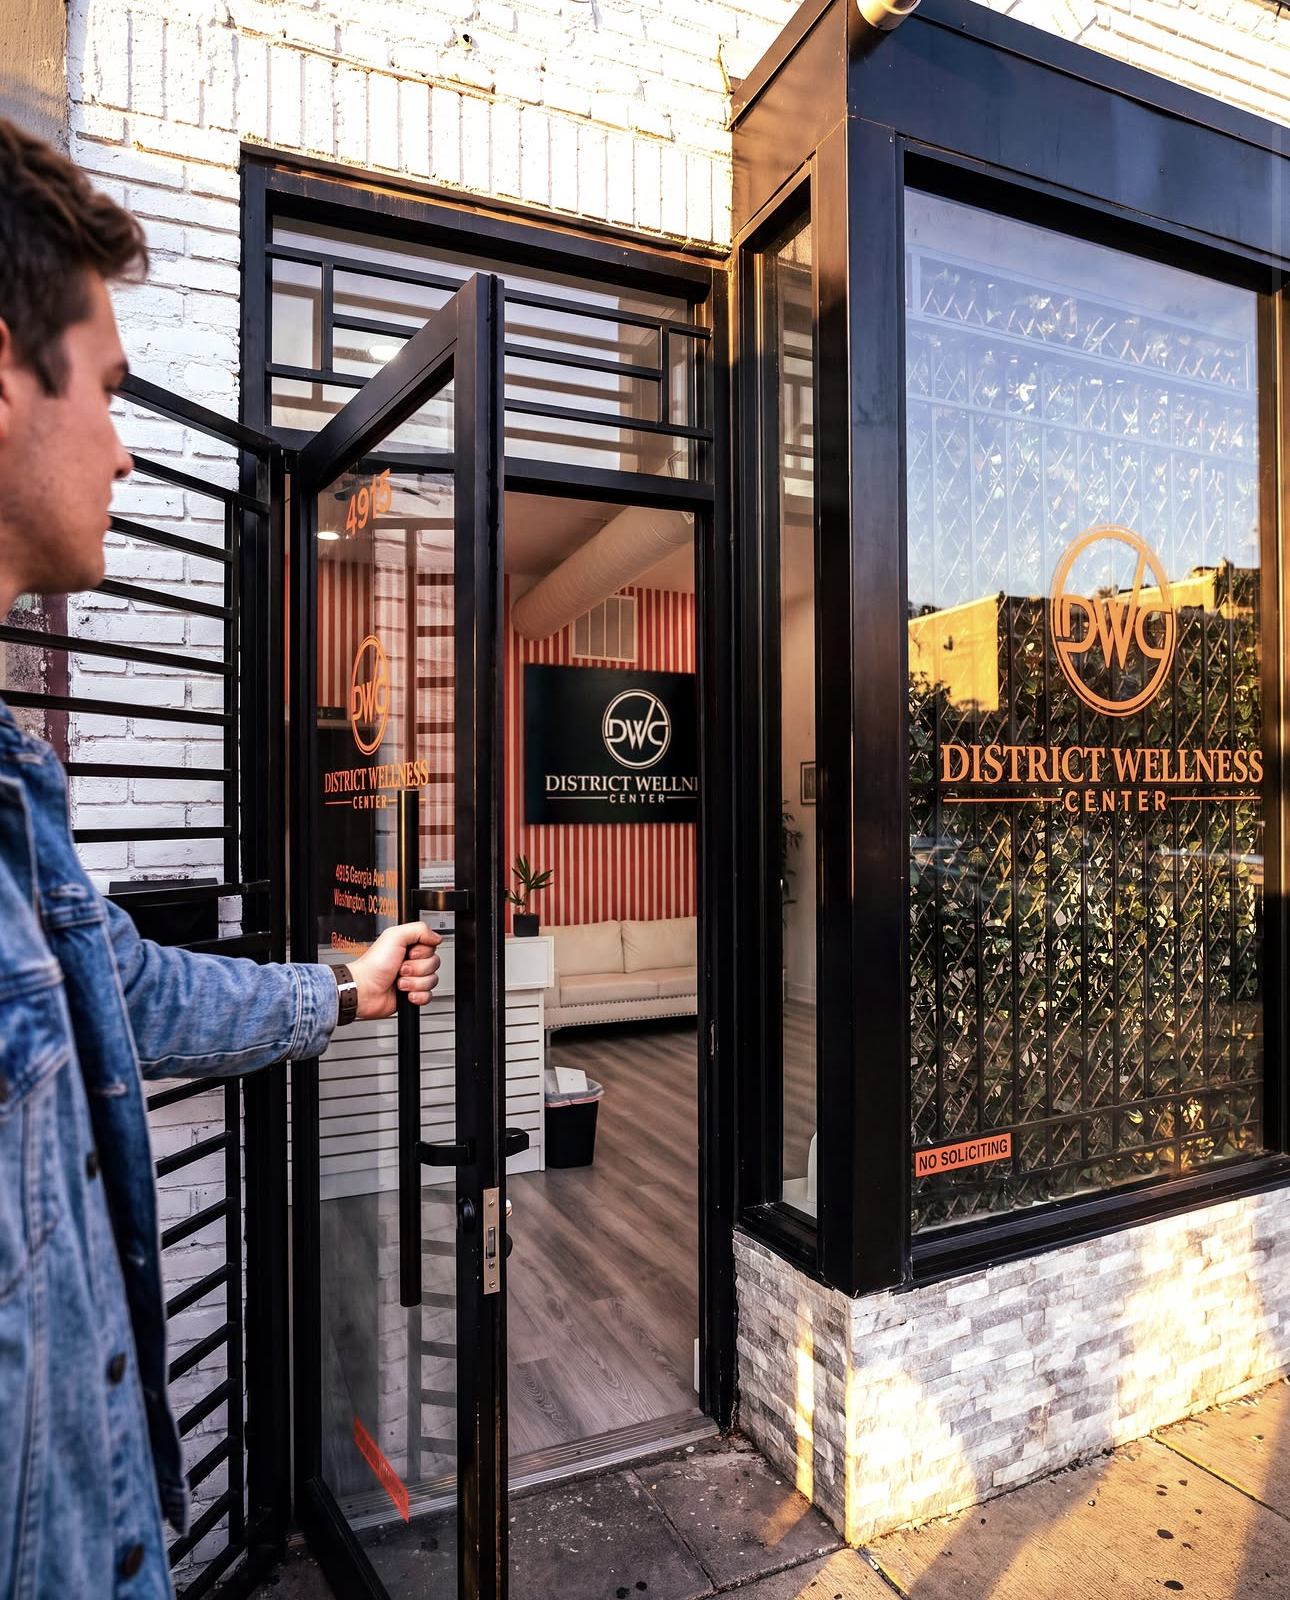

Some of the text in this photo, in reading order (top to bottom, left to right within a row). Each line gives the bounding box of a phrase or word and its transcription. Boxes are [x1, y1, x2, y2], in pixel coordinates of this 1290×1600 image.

[346, 468, 392, 536] 4915
[940, 744, 1264, 784] DISTRICT WELLNESS
[324, 759, 429, 793] DISTRICT WELLNESS
[545, 774, 698, 792] DISTRICT WELLN
[353, 795, 387, 809] CENTER
[609, 793, 665, 803] CENTER
[1064, 790, 1167, 812] CENTER
[335, 863, 350, 883] 4915
[350, 865, 372, 889] Georgia
[373, 868, 385, 888] Ave
[368, 894, 378, 914] DC
[919, 1154, 937, 1171] NO
